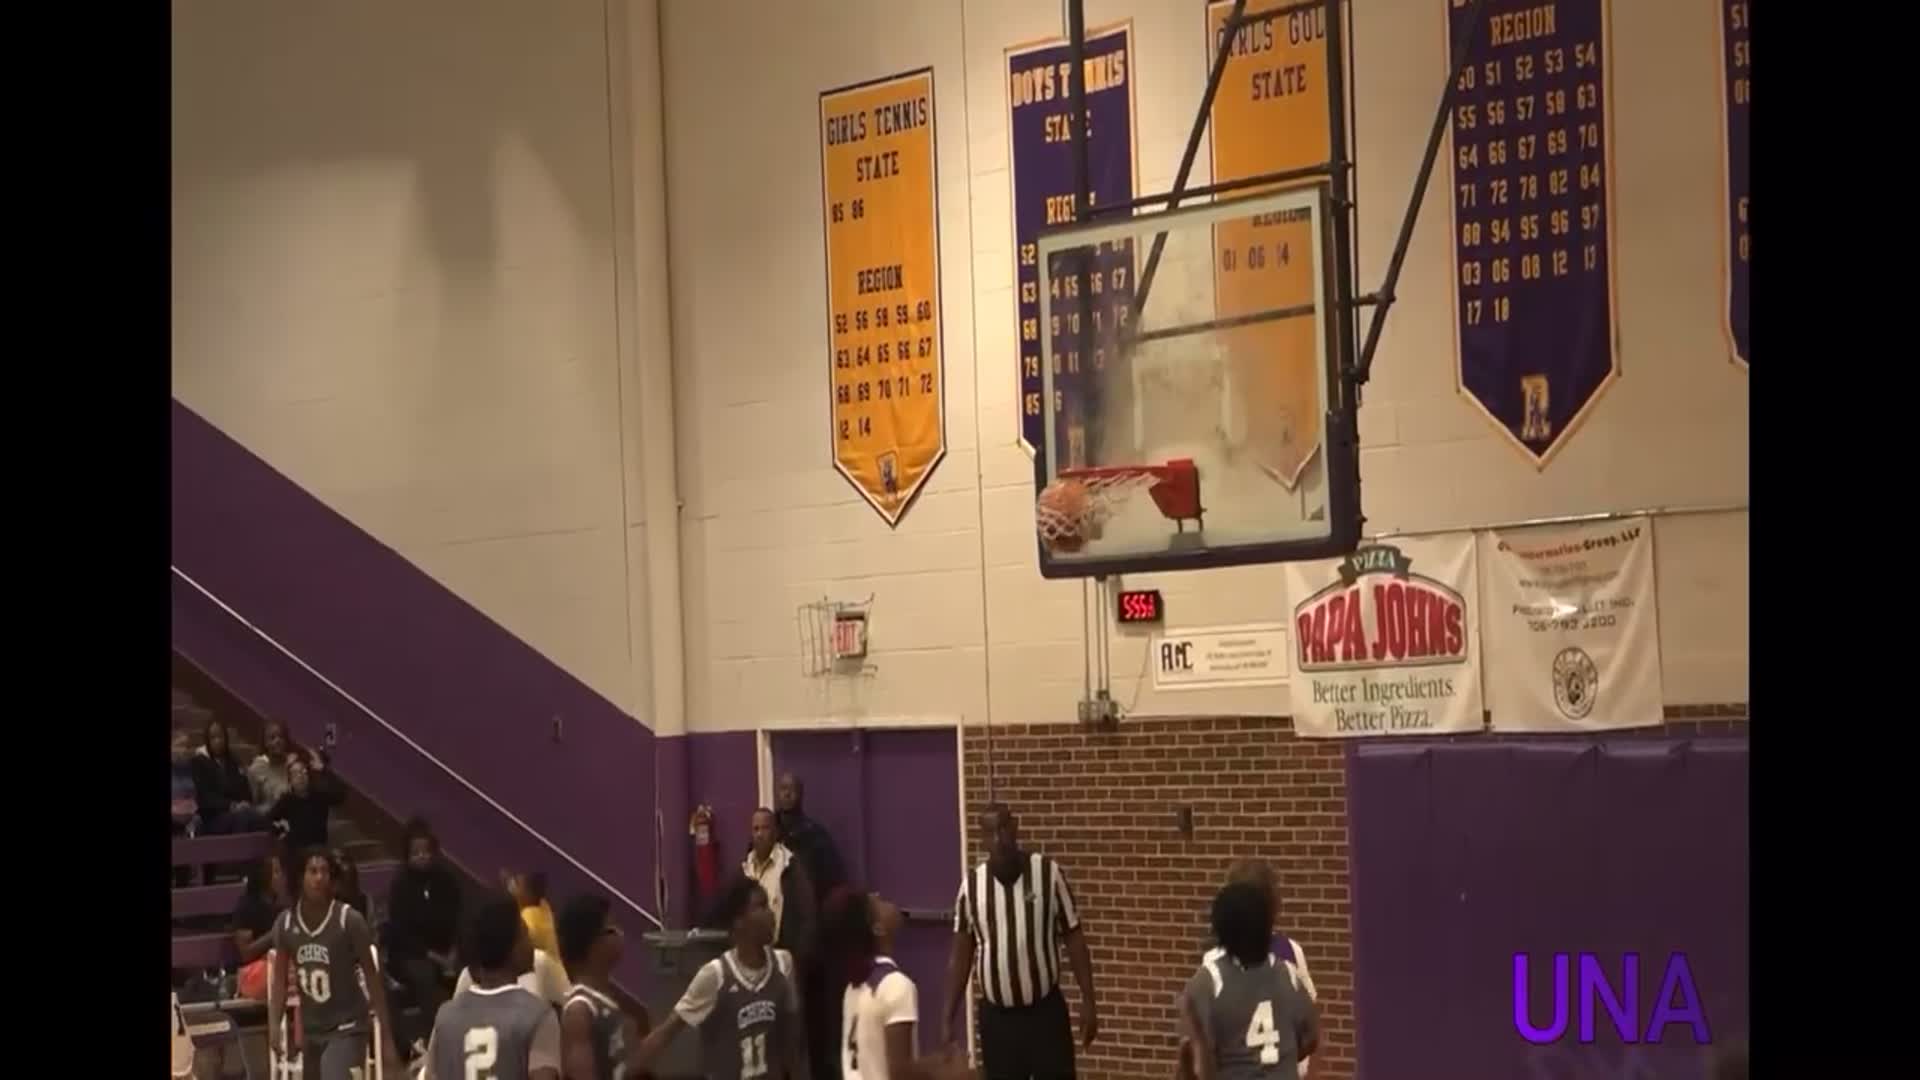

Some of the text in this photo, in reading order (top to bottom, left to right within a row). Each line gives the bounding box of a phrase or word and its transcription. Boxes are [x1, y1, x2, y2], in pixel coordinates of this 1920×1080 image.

[1490, 5, 1555, 46] REGION
[1485, 62, 1501, 86] 51
[1515, 56, 1533, 81] 52
[1545, 49, 1563, 74] 53
[1575, 42, 1595, 69] 54
[1012, 64, 1054, 108] BOYS
[1252, 64, 1306, 101] STATE
[827, 97, 927, 146] GIRLS TENNIS
[1459, 105, 1476, 129] 55
[1487, 100, 1505, 126] 56
[1516, 96, 1534, 121] 57
[1577, 83, 1596, 110] 63
[1459, 124, 1598, 170] 64 66 67 69 70
[857, 151, 899, 182] STATE
[1460, 184, 1476, 208] 71
[1490, 179, 1508, 205] 72
[1491, 218, 1510, 244] 94
[1520, 215, 1538, 241] 95
[1551, 210, 1569, 235] 96
[1581, 205, 1599, 230] 97
[1021, 244, 1036, 265] 52
[1463, 261, 1480, 286] 03
[1552, 250, 1568, 276] 12
[858, 264, 903, 295] REGION
[1022, 283, 1036, 304] 63
[836, 314, 848, 333] 52
[1467, 299, 1481, 325] 17
[856, 346, 870, 367] 64
[918, 337, 932, 358] 67
[1024, 356, 1039, 378] 79
[878, 379, 891, 399] 70
[898, 377, 910, 397] 71
[920, 373, 932, 394] 72
[858, 416, 871, 436] 14
[1352, 551, 1395, 571] PIZZA
[1298, 582, 1463, 663] PAPA JOHNS
[1313, 675, 1457, 707] Better Ingredients.
[1336, 704, 1434, 732] Better Pizza.
[298, 967, 331, 1003] 10
[1246, 1000, 1280, 1064] 4
[464, 1026, 499, 1080] 2
[740, 1033, 769, 1079] 11
